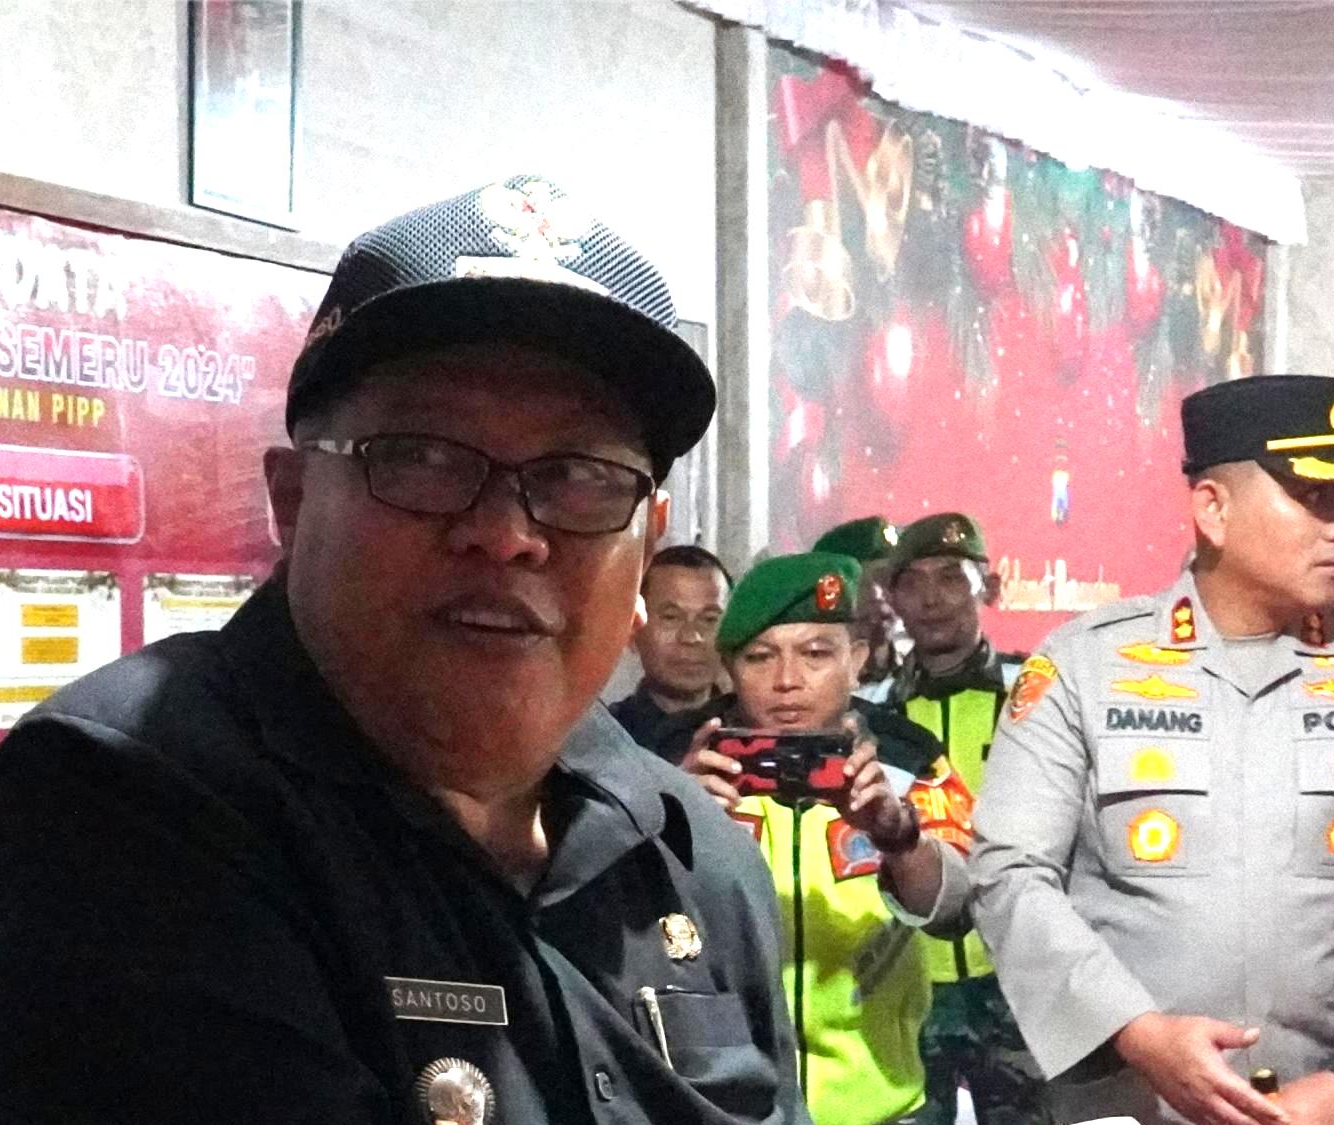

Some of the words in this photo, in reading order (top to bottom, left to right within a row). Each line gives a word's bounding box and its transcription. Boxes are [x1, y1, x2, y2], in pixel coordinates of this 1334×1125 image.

[51, 390, 106, 428] PIPP
[1105, 707, 1203, 734] DANANG
[390, 987, 487, 1014] SANTOSO
